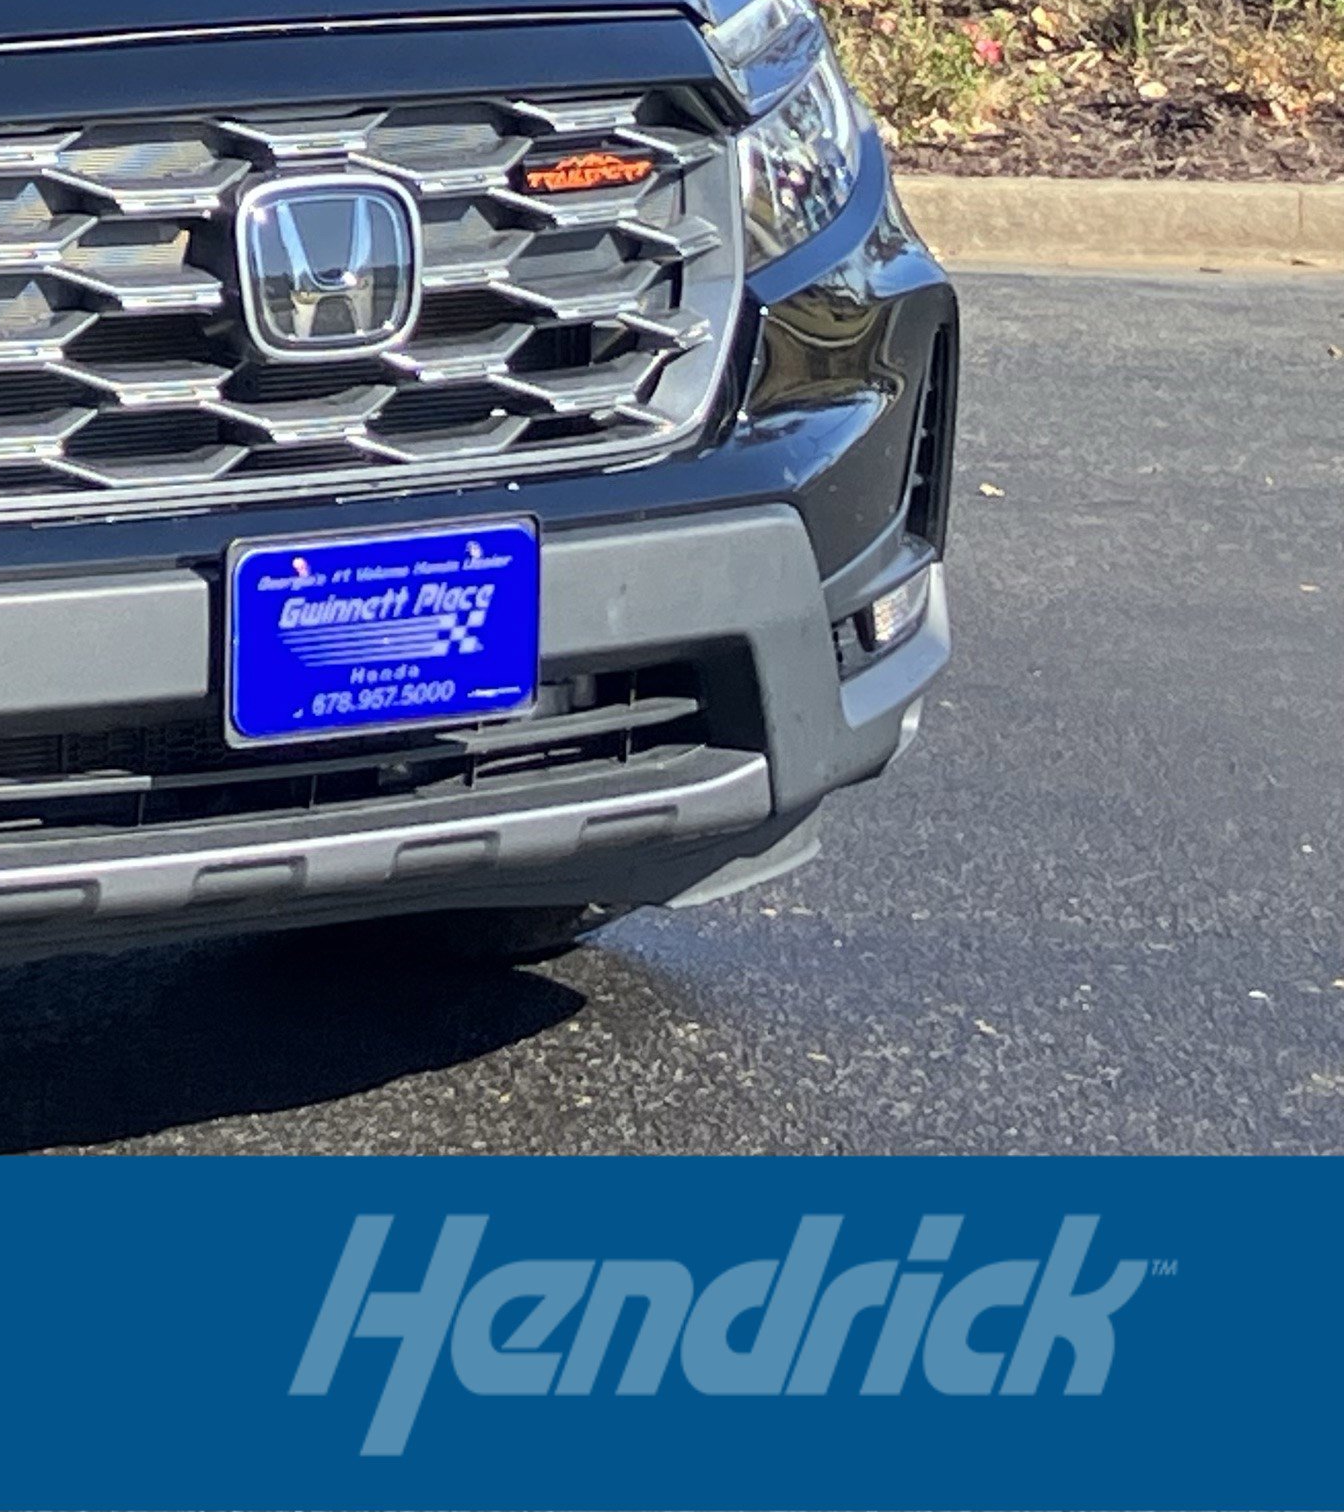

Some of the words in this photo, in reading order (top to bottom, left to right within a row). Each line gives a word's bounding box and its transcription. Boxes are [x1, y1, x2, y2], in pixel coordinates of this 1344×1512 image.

[278, 587, 409, 629] Gwinnett
[413, 583, 495, 616] Place
[349, 663, 421, 685] Honda
[311, 679, 457, 718] 678.957.5000
